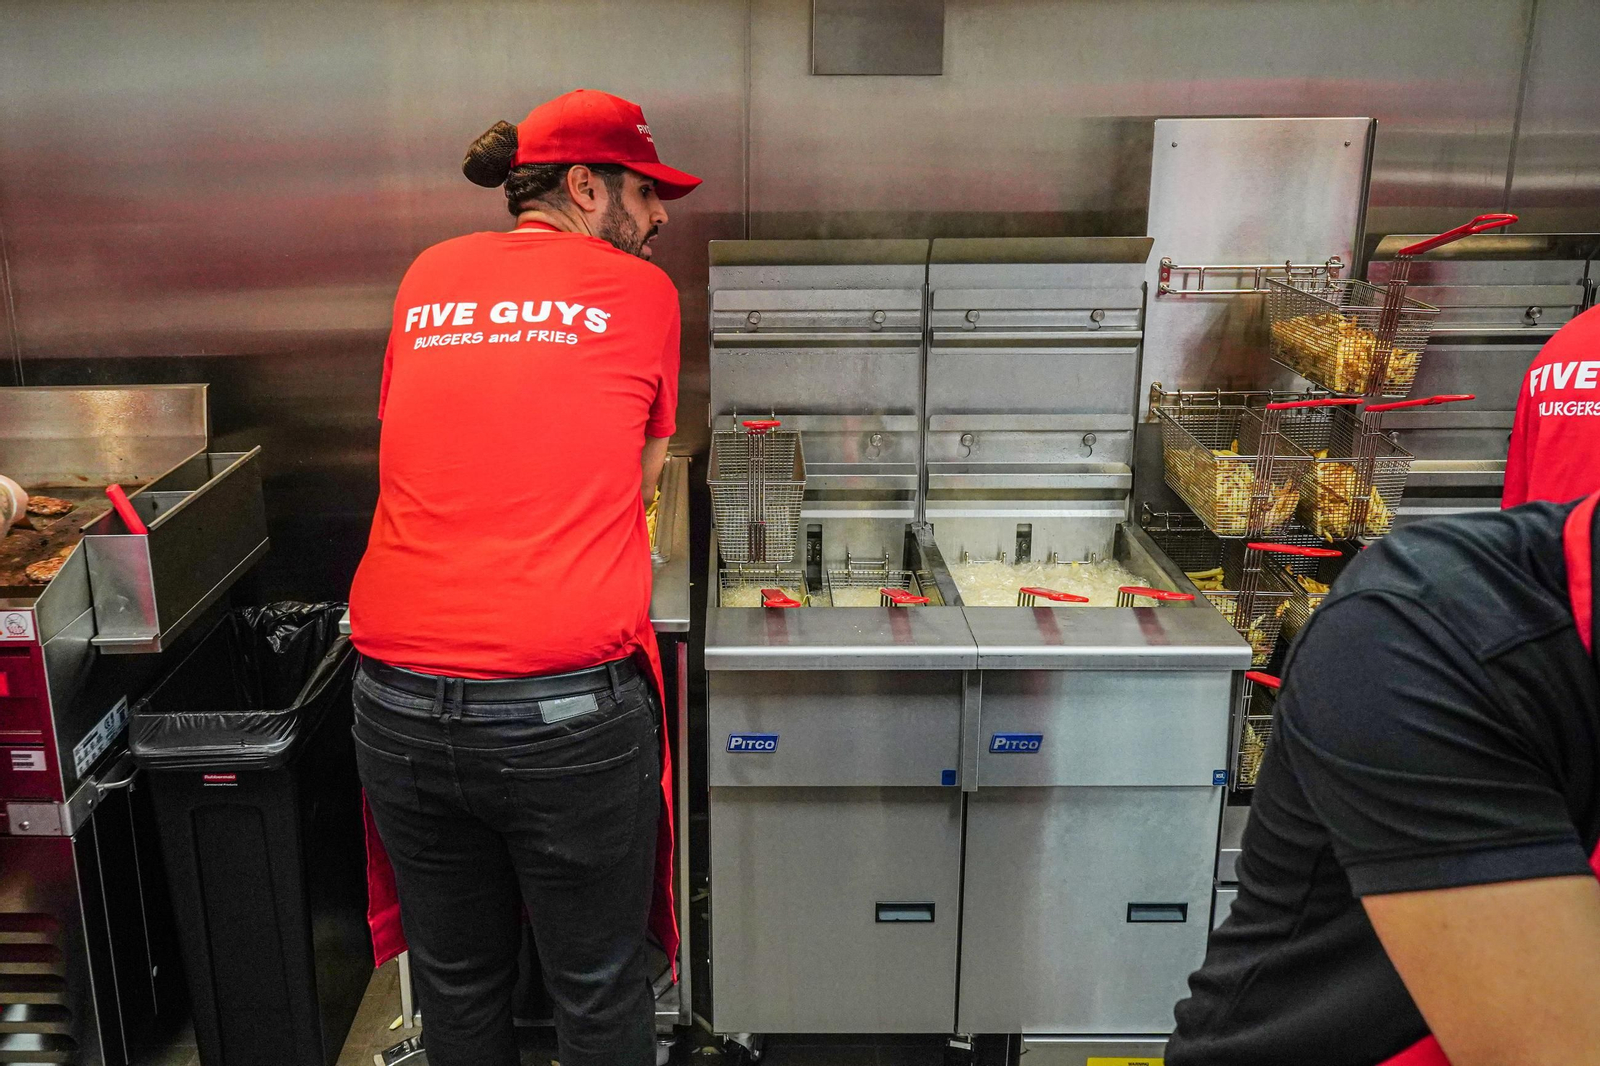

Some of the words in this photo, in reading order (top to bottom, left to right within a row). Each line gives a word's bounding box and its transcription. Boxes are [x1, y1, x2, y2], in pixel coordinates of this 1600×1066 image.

[404, 302, 478, 333] FIVE
[489, 301, 609, 334] GUYS
[413, 331, 484, 350] BURGERS
[488, 330, 522, 343] and
[526, 330, 578, 345] FRIES
[1530, 361, 1600, 397] FIVE
